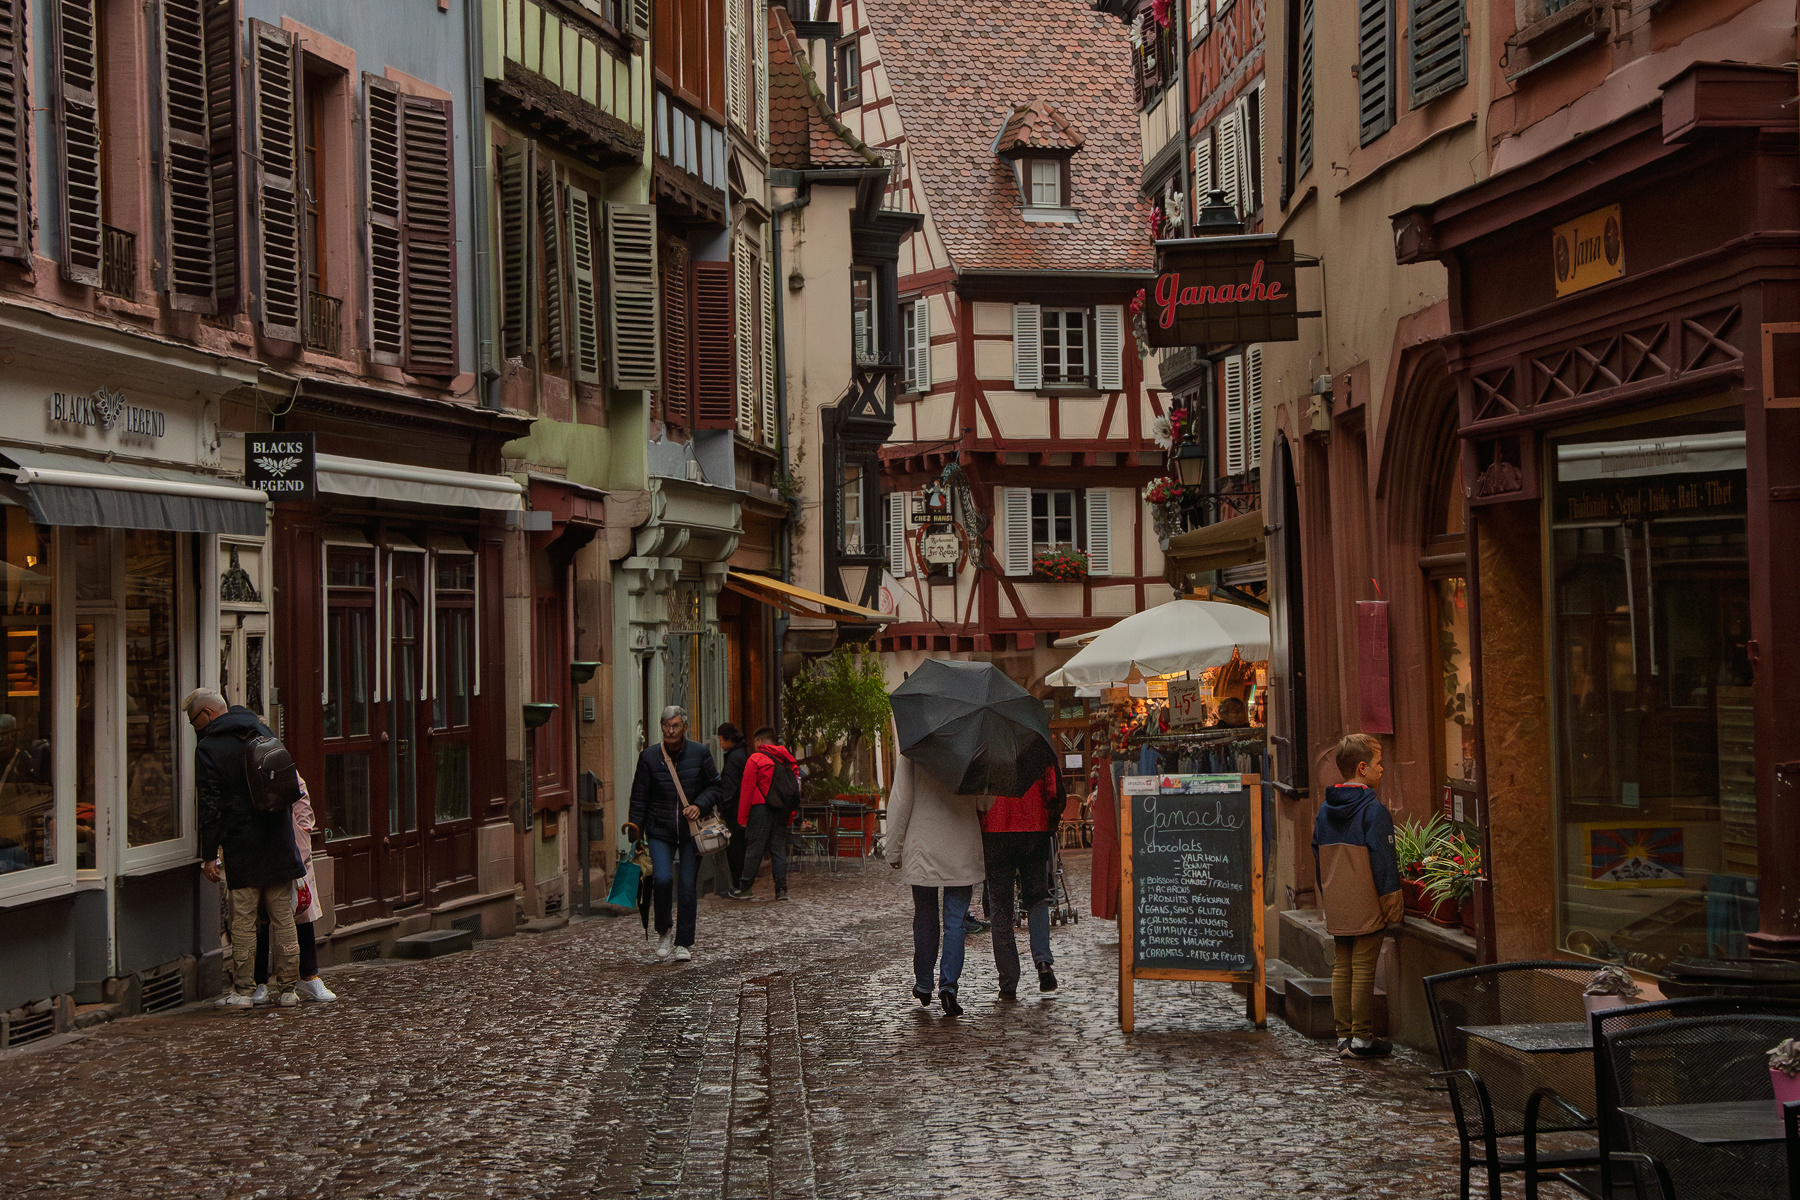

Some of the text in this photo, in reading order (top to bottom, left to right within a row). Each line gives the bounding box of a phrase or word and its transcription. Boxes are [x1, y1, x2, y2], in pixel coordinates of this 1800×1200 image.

[1571, 228, 1600, 280] Jana
[53, 392, 165, 438] BLACKS LEGEND
[252, 441, 303, 454] BLACKS
[251, 480, 305, 492] LEGEND
[1704, 480, 1733, 506] Tibet
[1181, 853, 1229, 864] VALRHONA
[1181, 869, 1214, 880] SCHAAL
[1148, 885, 1190, 894] MACARONS
[1173, 905, 1194, 915] SANS
[1147, 925, 1198, 937] GUIMAUVES
[1149, 936, 1179, 946] BARRES
